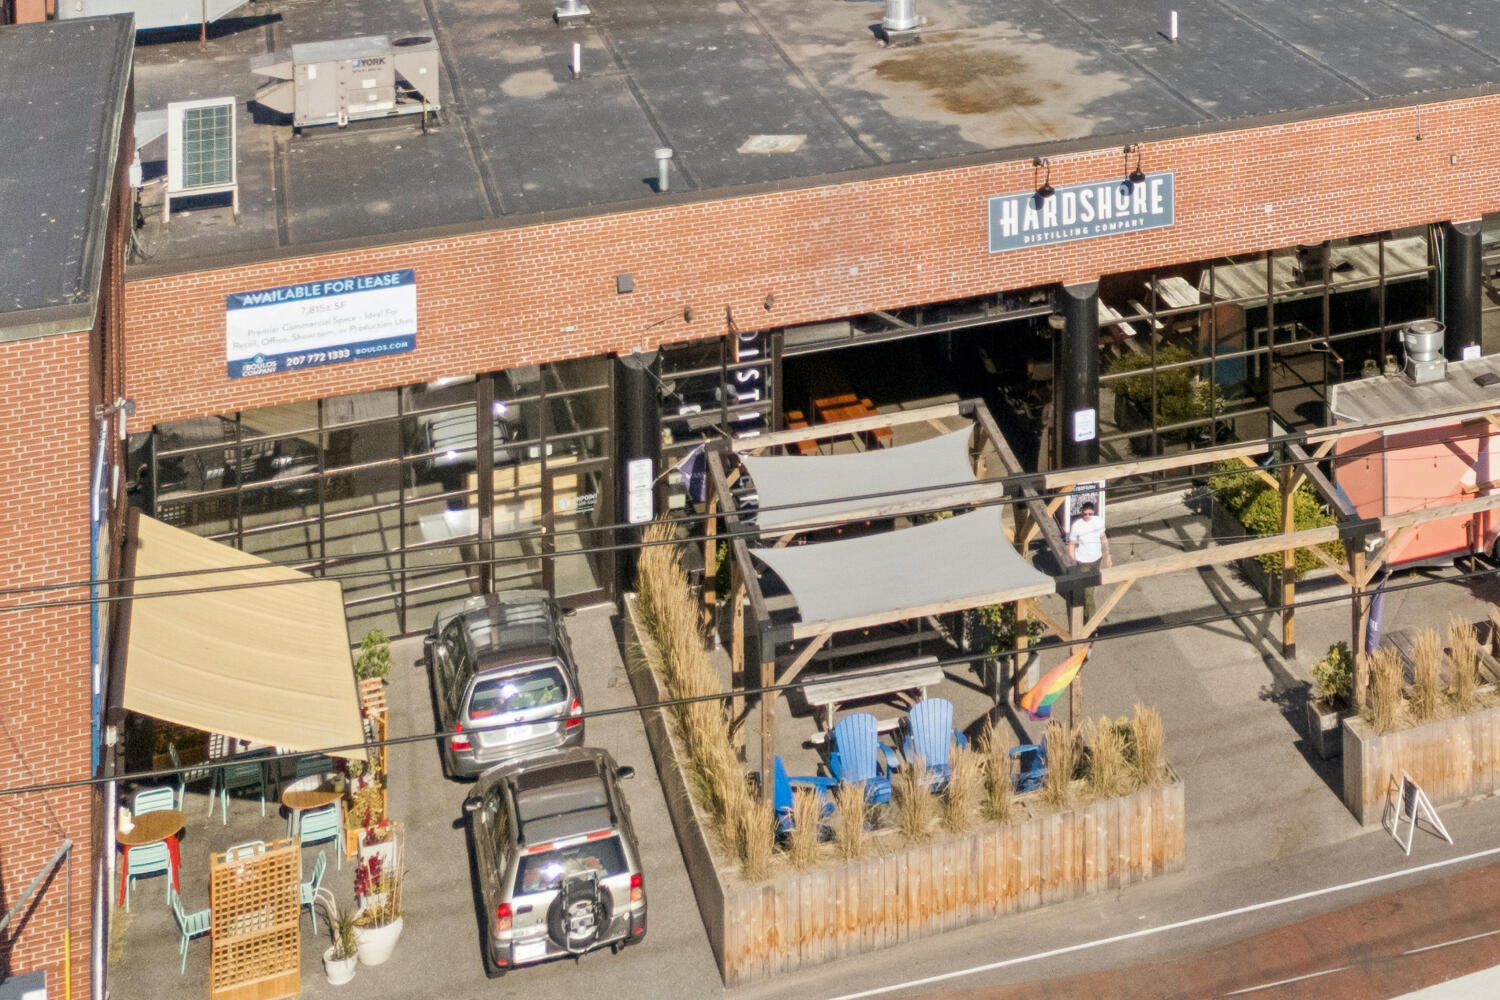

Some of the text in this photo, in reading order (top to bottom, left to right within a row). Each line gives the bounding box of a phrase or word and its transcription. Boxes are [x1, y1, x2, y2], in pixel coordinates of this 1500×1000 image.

[360, 57, 386, 67] YORK
[1000, 178, 1164, 237] HARDSHORE
[1024, 218, 1145, 244] DISTILLING COMPANY
[242, 273, 400, 306] AVAILABLE FOR LEASE
[334, 301, 346, 311] SF
[355, 341, 408, 354] BOULOS.COM
[286, 349, 350, 367] 207 772 1333
[242, 367, 276, 377] COMPANY
[245, 361, 277, 371] BOULOS
